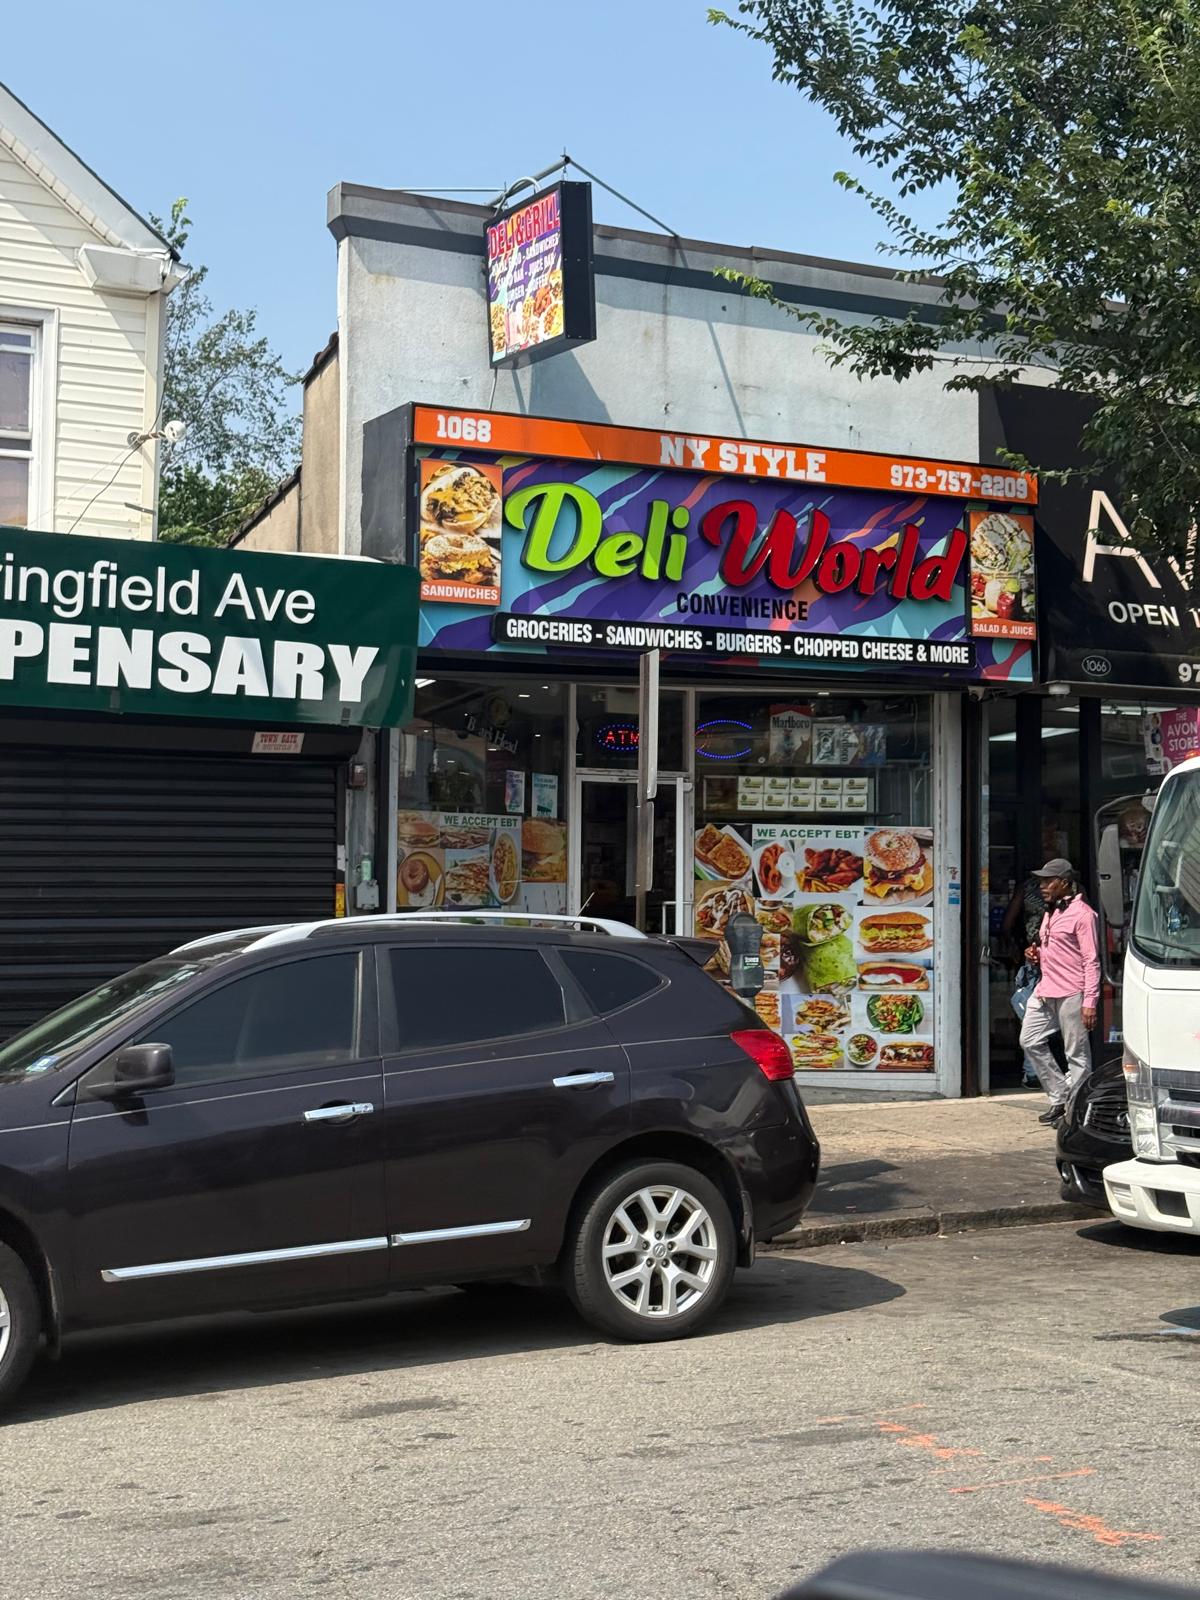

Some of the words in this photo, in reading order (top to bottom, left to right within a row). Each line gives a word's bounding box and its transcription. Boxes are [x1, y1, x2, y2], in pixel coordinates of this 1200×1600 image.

[436, 414, 491, 443] 1068
[660, 435, 710, 468] NY
[719, 443, 826, 482] STYLE
[890, 464, 1028, 499] 973-757-2209
[504, 481, 690, 581] Deli
[702, 500, 967, 601] World
[0, 552, 200, 619] ingfield
[214, 572, 316, 625] Ave
[422, 584, 498, 600] SANDWICHES
[677, 592, 808, 621] CONVENIENCE
[1108, 601, 1180, 627] OPEN
[973, 623, 999, 634] SALAD
[1001, 624, 1008, 634] &
[1010, 625, 1033, 636] JUICE
[506, 619, 592, 643] GROCERIES
[606, 625, 703, 650] SANDWICHES
[716, 633, 783, 655] BURGERS
[794, 637, 859, 659] CHOPPED
[862, 640, 913, 661] CHEESE
[916, 643, 927, 662] &
[930, 645, 969, 664] MORE
[0, 619, 379, 702] PENSARY
[1085, 659, 1107, 672] 1066
[772, 715, 810, 729] Marlboro
[1176, 712, 1187, 721] THE
[1167, 721, 1198, 737] AVON
[605, 731, 640, 744] ATM
[1168, 736, 1199, 752] STORE
[444, 815, 459, 825] WE
[461, 816, 498, 827] ACCEPT
[500, 818, 518, 828] EBT
[757, 828, 776, 838] WE
[780, 829, 831, 839] ACCEPT
[835, 830, 860, 839] EBT
